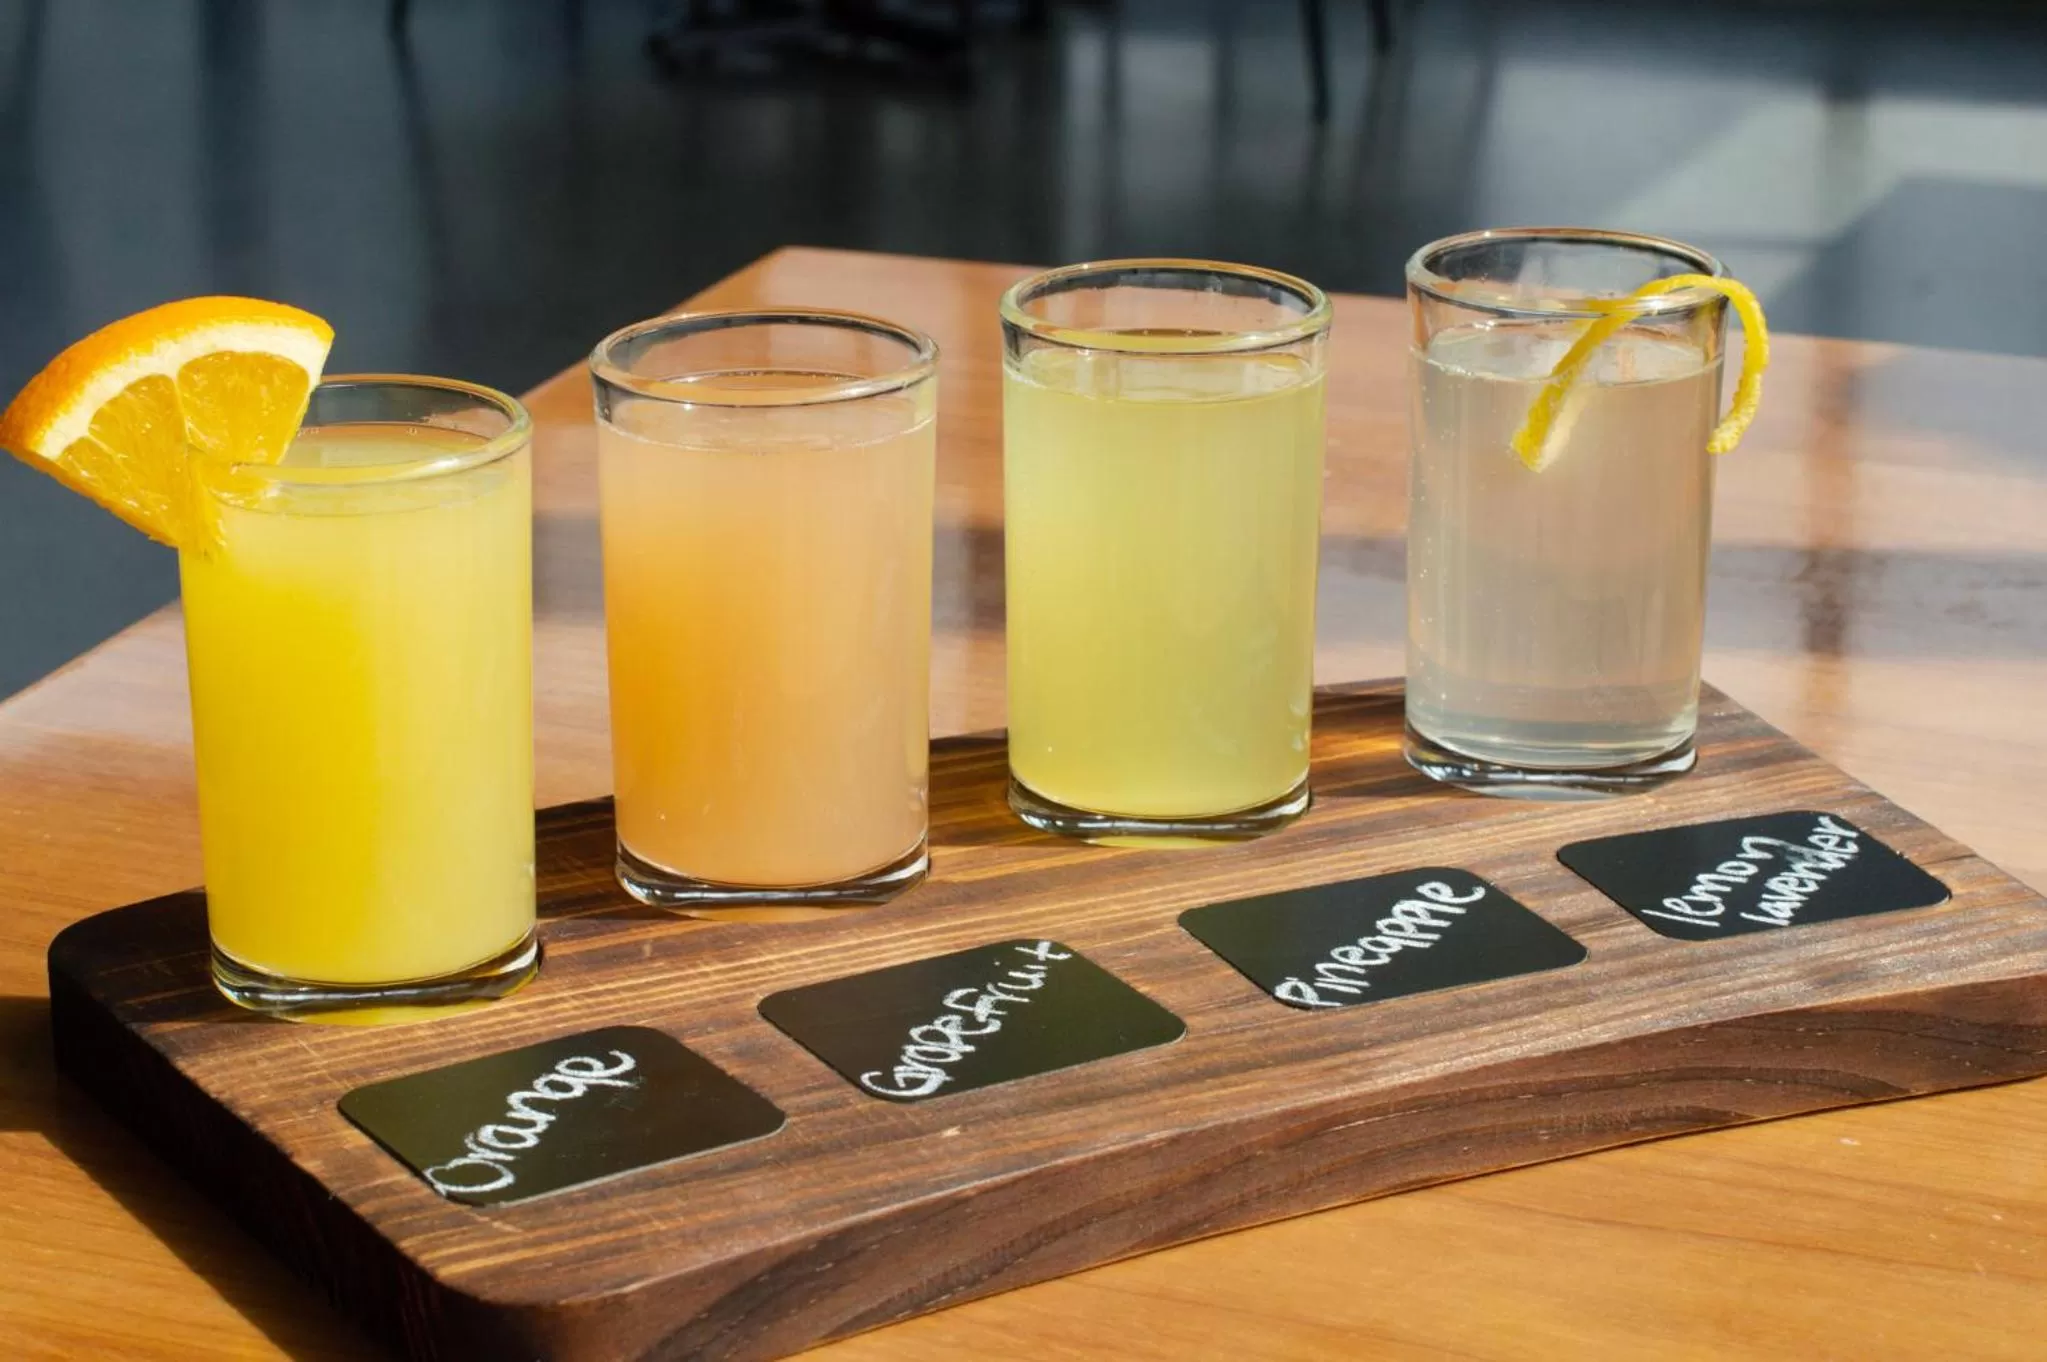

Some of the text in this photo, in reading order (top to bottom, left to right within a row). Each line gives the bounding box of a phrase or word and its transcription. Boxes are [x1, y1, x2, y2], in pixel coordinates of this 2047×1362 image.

[1641, 835, 1783, 927] lemon
[1739, 815, 1860, 926] lavender
[1274, 881, 1486, 1007] Pineapple
[860, 940, 1073, 1097] Grapefruit
[423, 1049, 640, 1196] Orange
